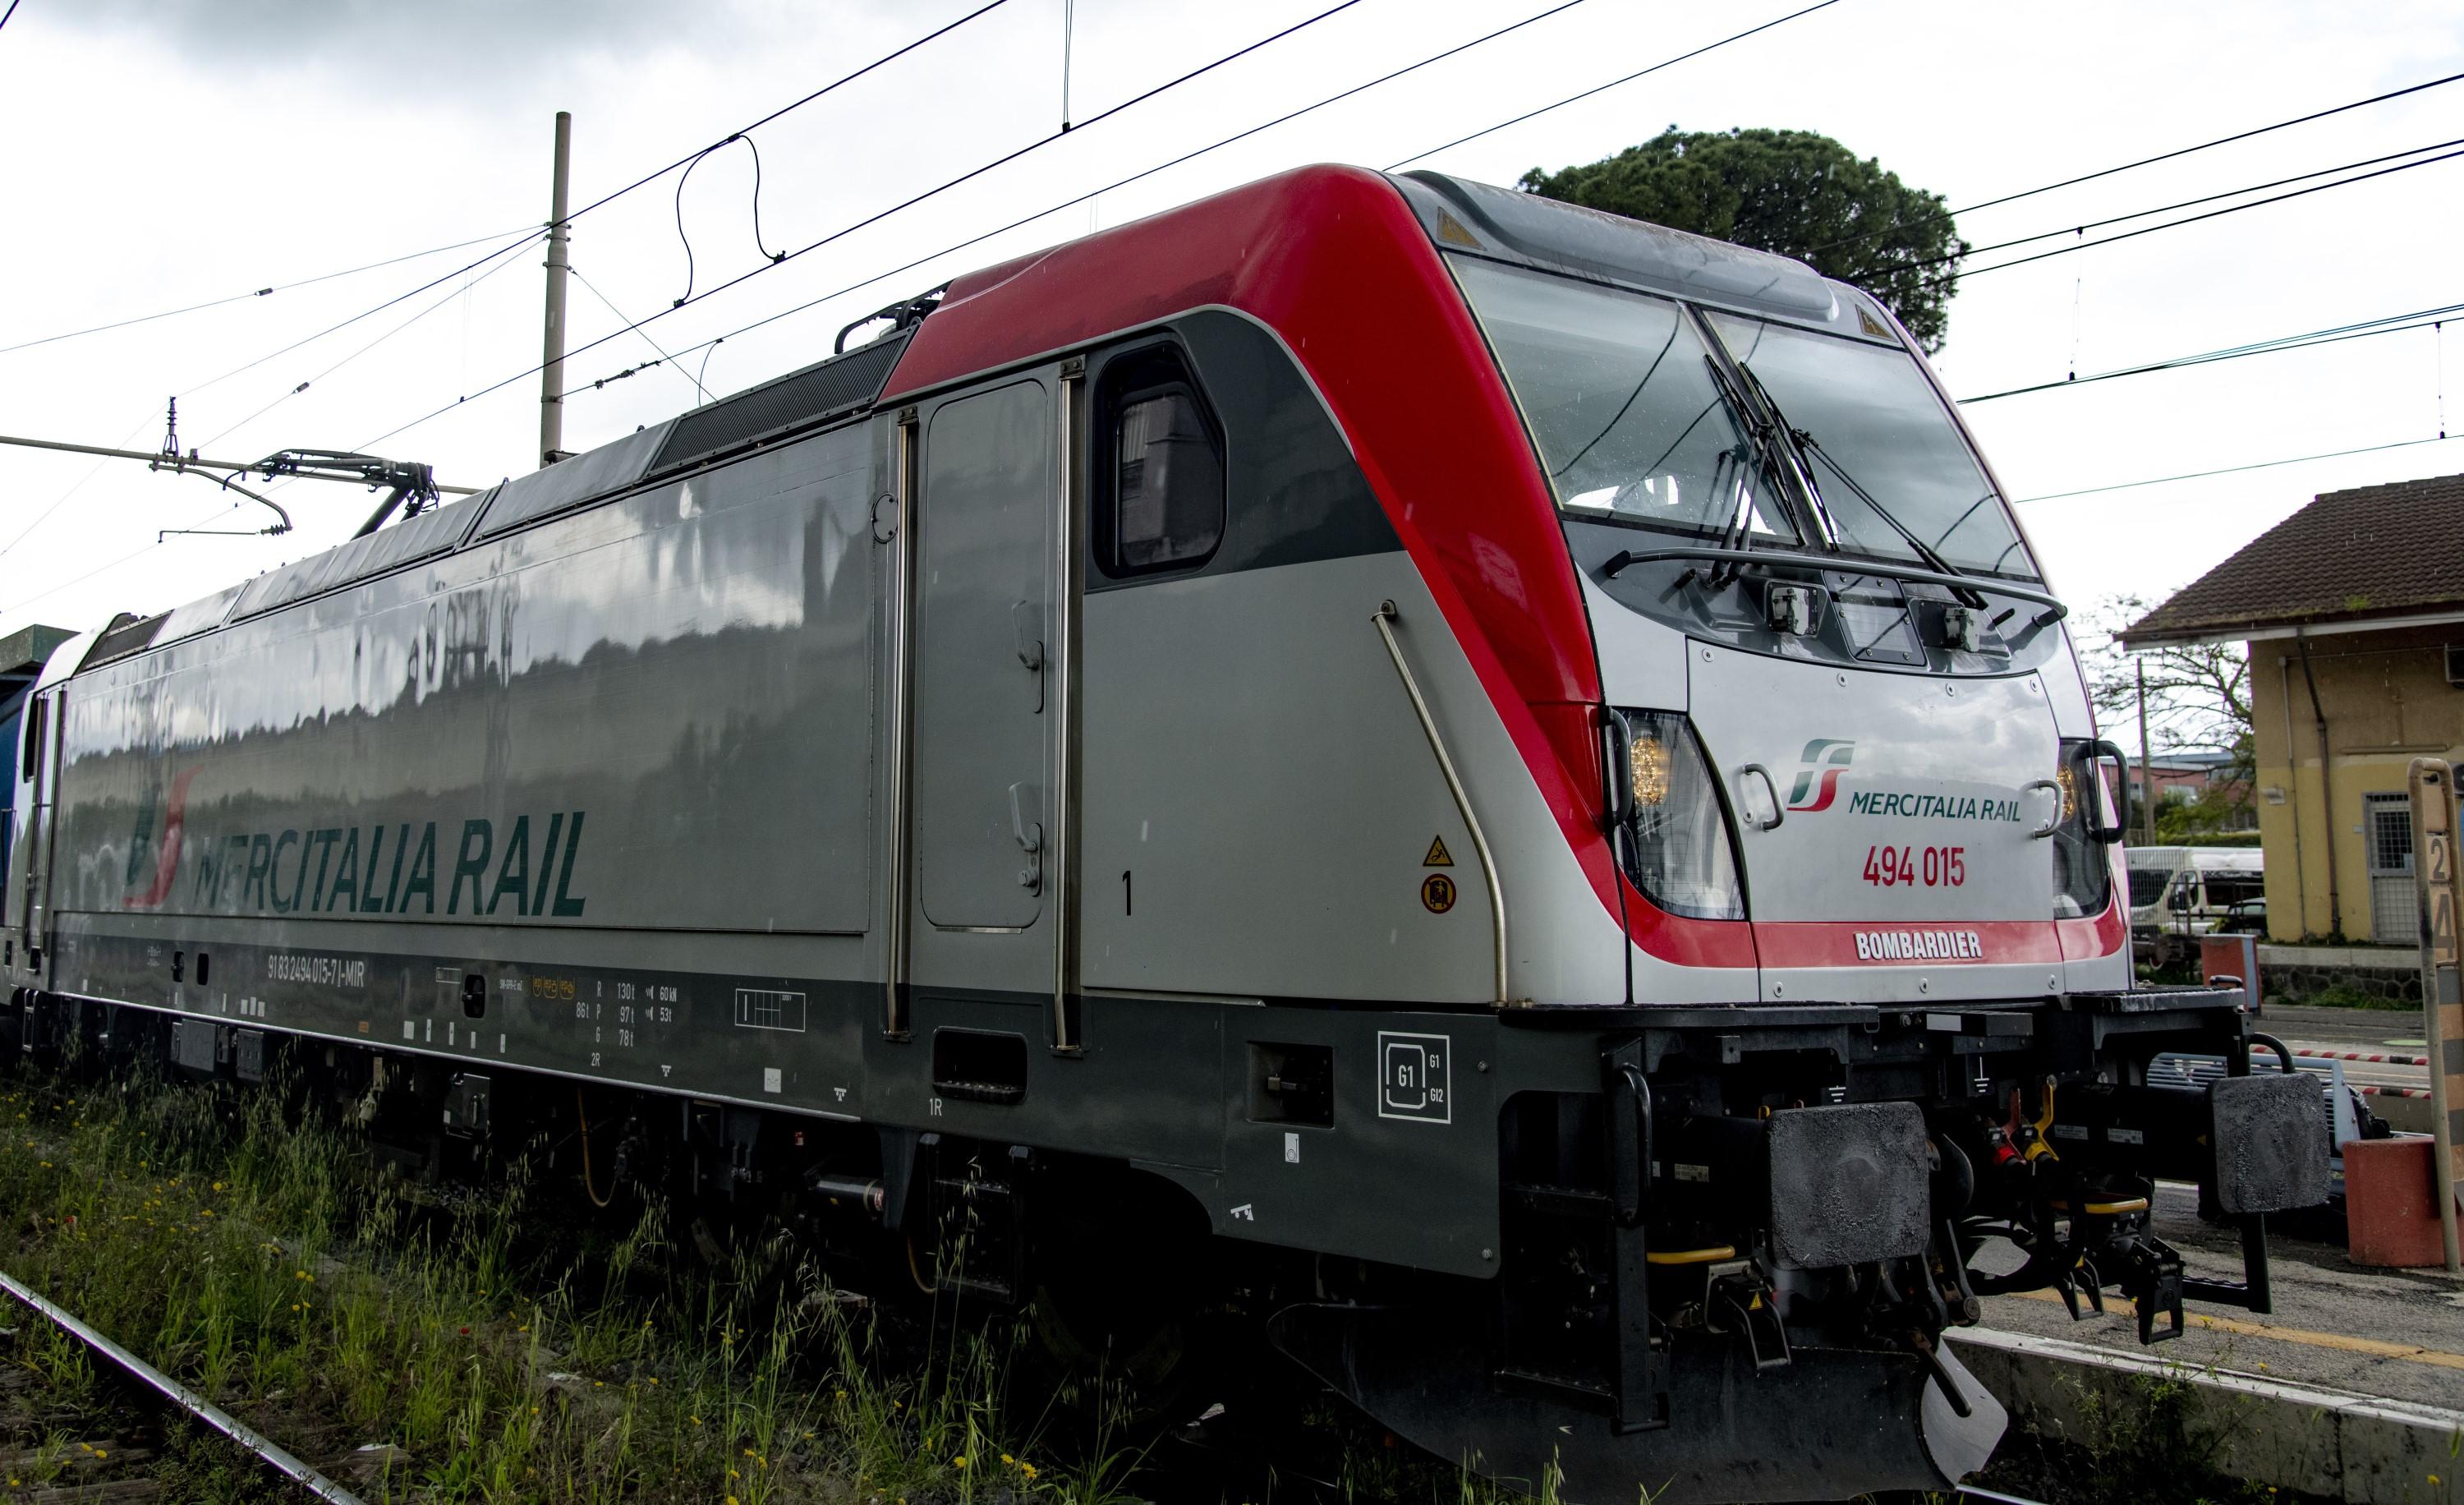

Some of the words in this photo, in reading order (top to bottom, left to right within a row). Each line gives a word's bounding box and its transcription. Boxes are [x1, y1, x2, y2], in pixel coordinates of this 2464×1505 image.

[1849, 791, 1976, 820] MERCITALIA
[1980, 799, 2021, 822] RAIL
[193, 822, 436, 914] MERCITALIA
[446, 811, 586, 918] RAIL
[1863, 845, 1915, 886] 494
[1924, 846, 1965, 886] 015
[1122, 870, 1132, 917] 1
[1855, 932, 1983, 960] BOMBARDIER
[596, 980, 602, 997] R
[596, 1003, 601, 1020] P
[595, 1026, 600, 1043] G
[591, 1052, 600, 1067] 2R
[1430, 1054, 1440, 1069] G1
[1398, 1064, 1414, 1088] G1
[929, 1098, 942, 1116] 1R
